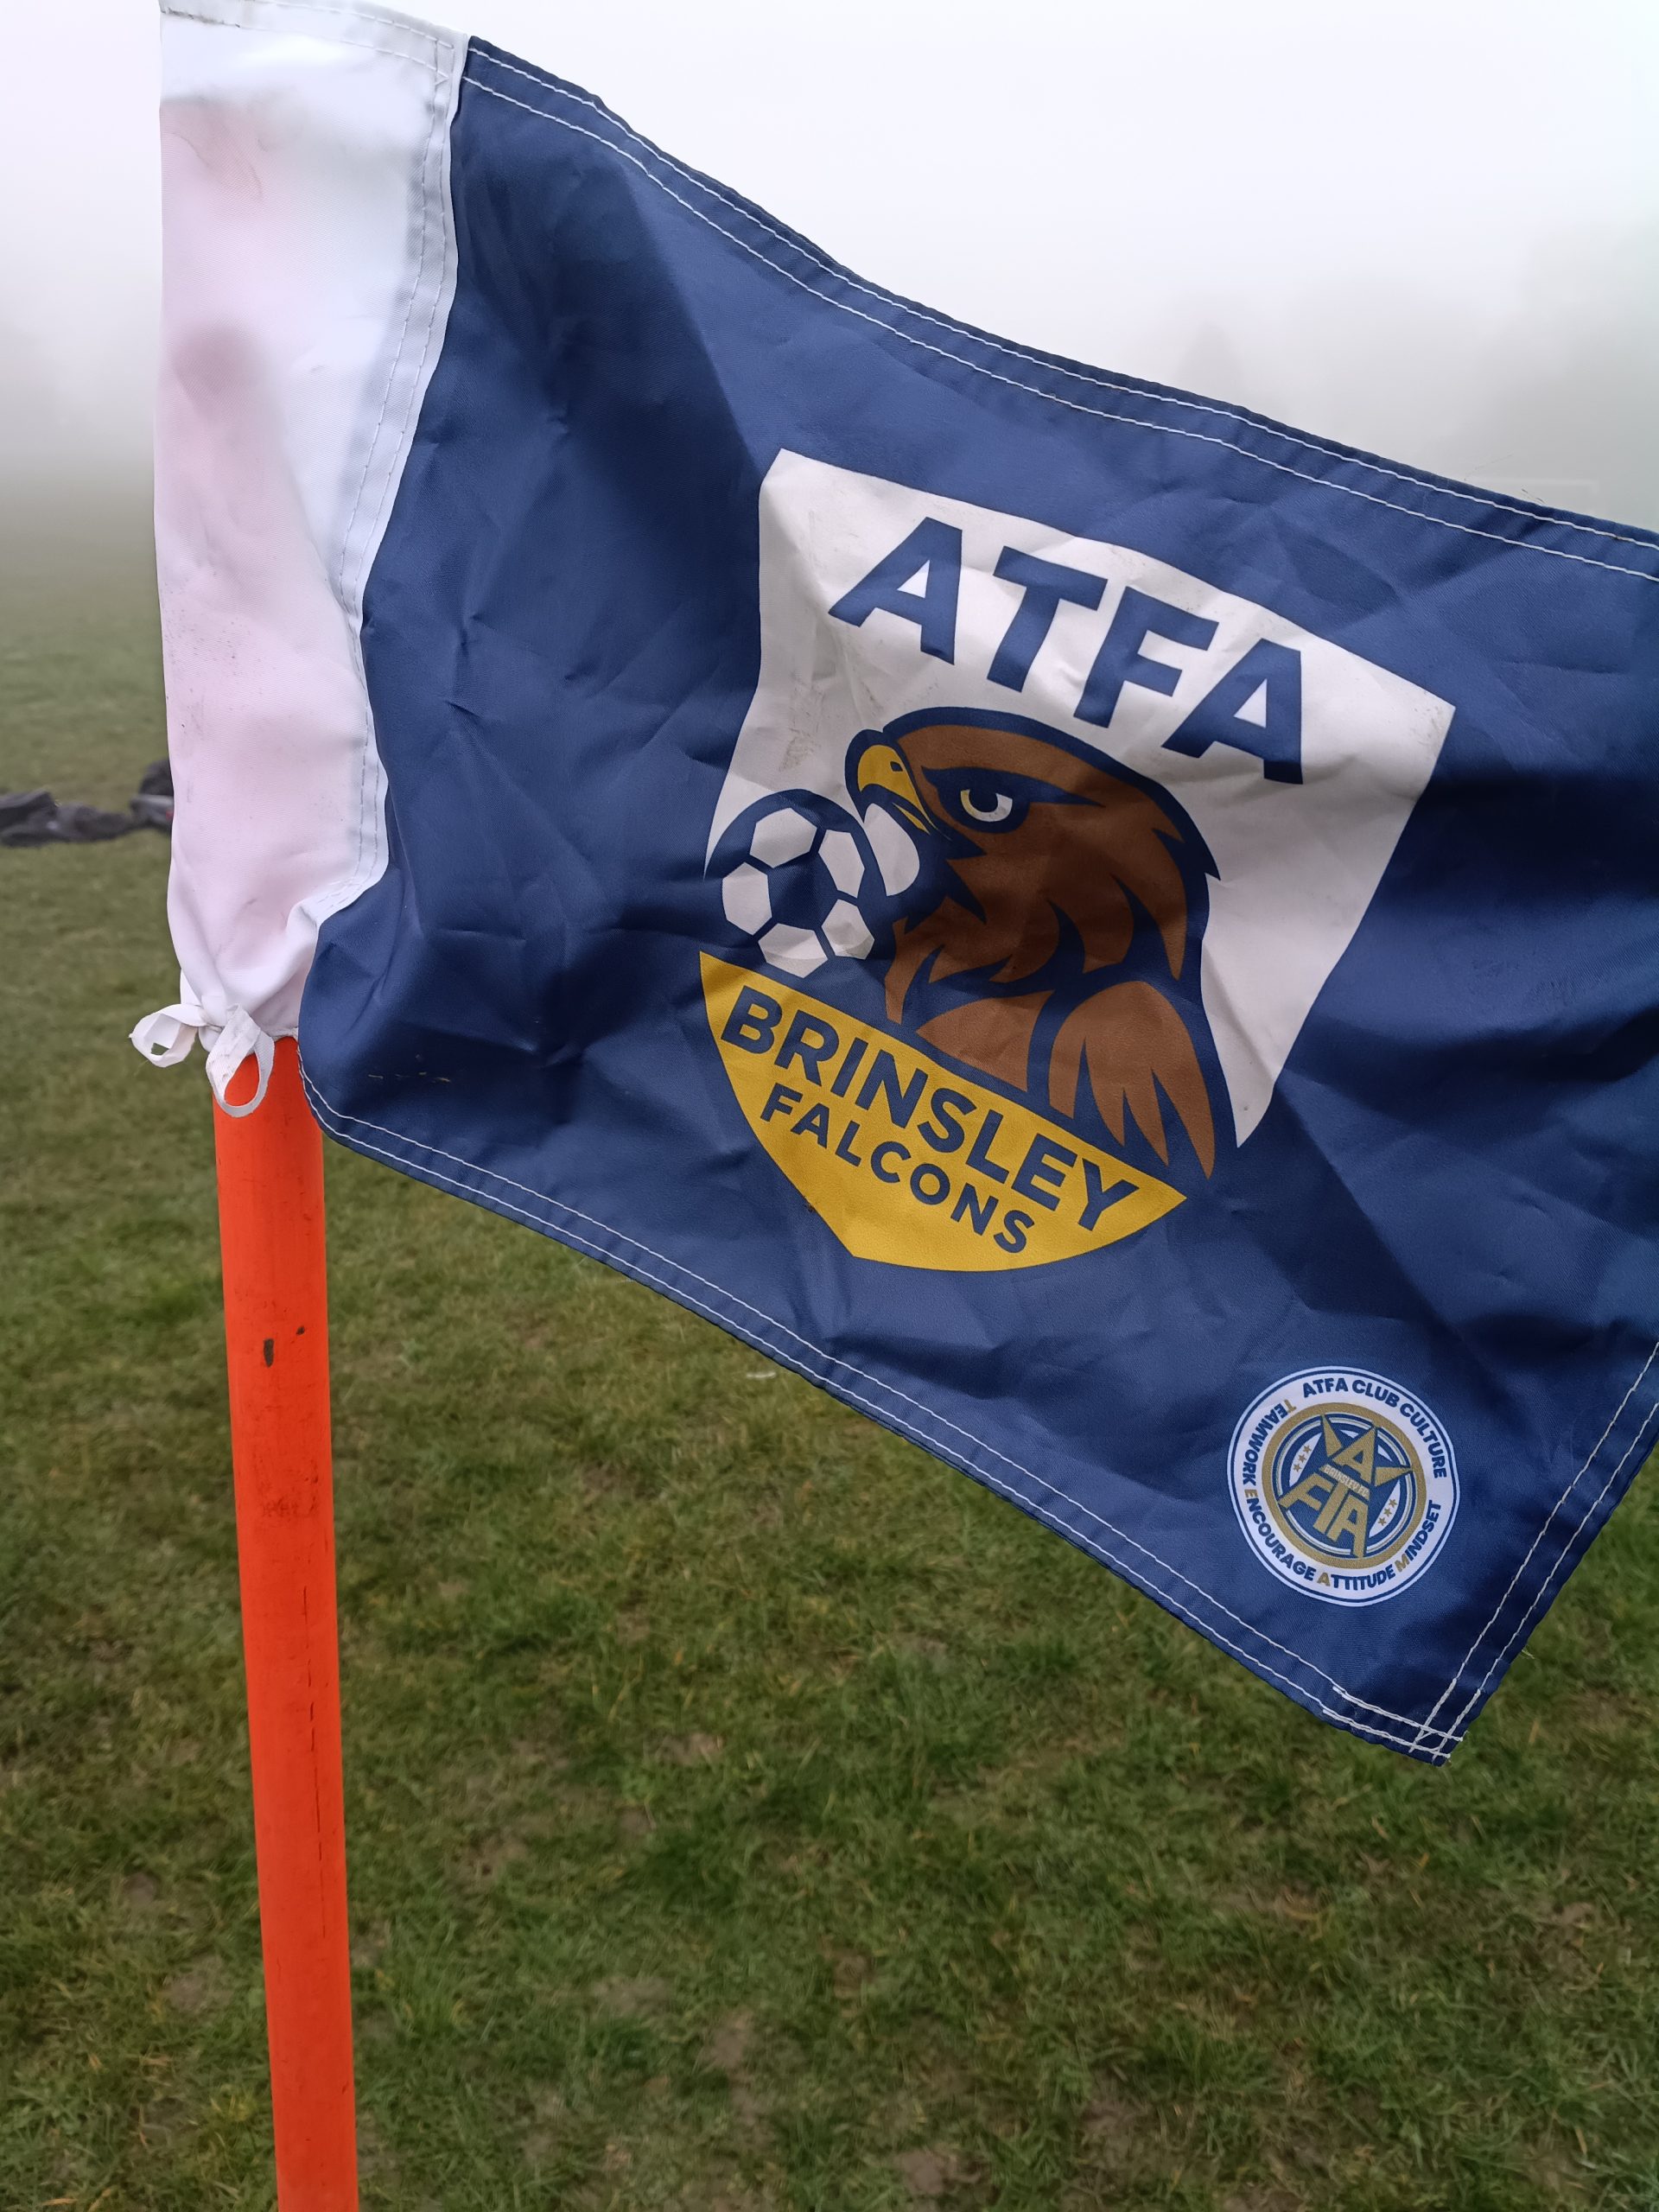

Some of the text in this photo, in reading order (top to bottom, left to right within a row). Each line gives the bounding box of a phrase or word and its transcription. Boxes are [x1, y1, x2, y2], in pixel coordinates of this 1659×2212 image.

[828, 516, 1304, 785] ATFA
[721, 985, 1140, 1230] BRINSLEY
[760, 1088, 1037, 1255] FALCONS
[1243, 1399, 1441, 1591] TEAMWORK ENCOURAGE ATTITUDE MINDSET
[1302, 1377, 1447, 1479] ATFA CLUB CULTURE
